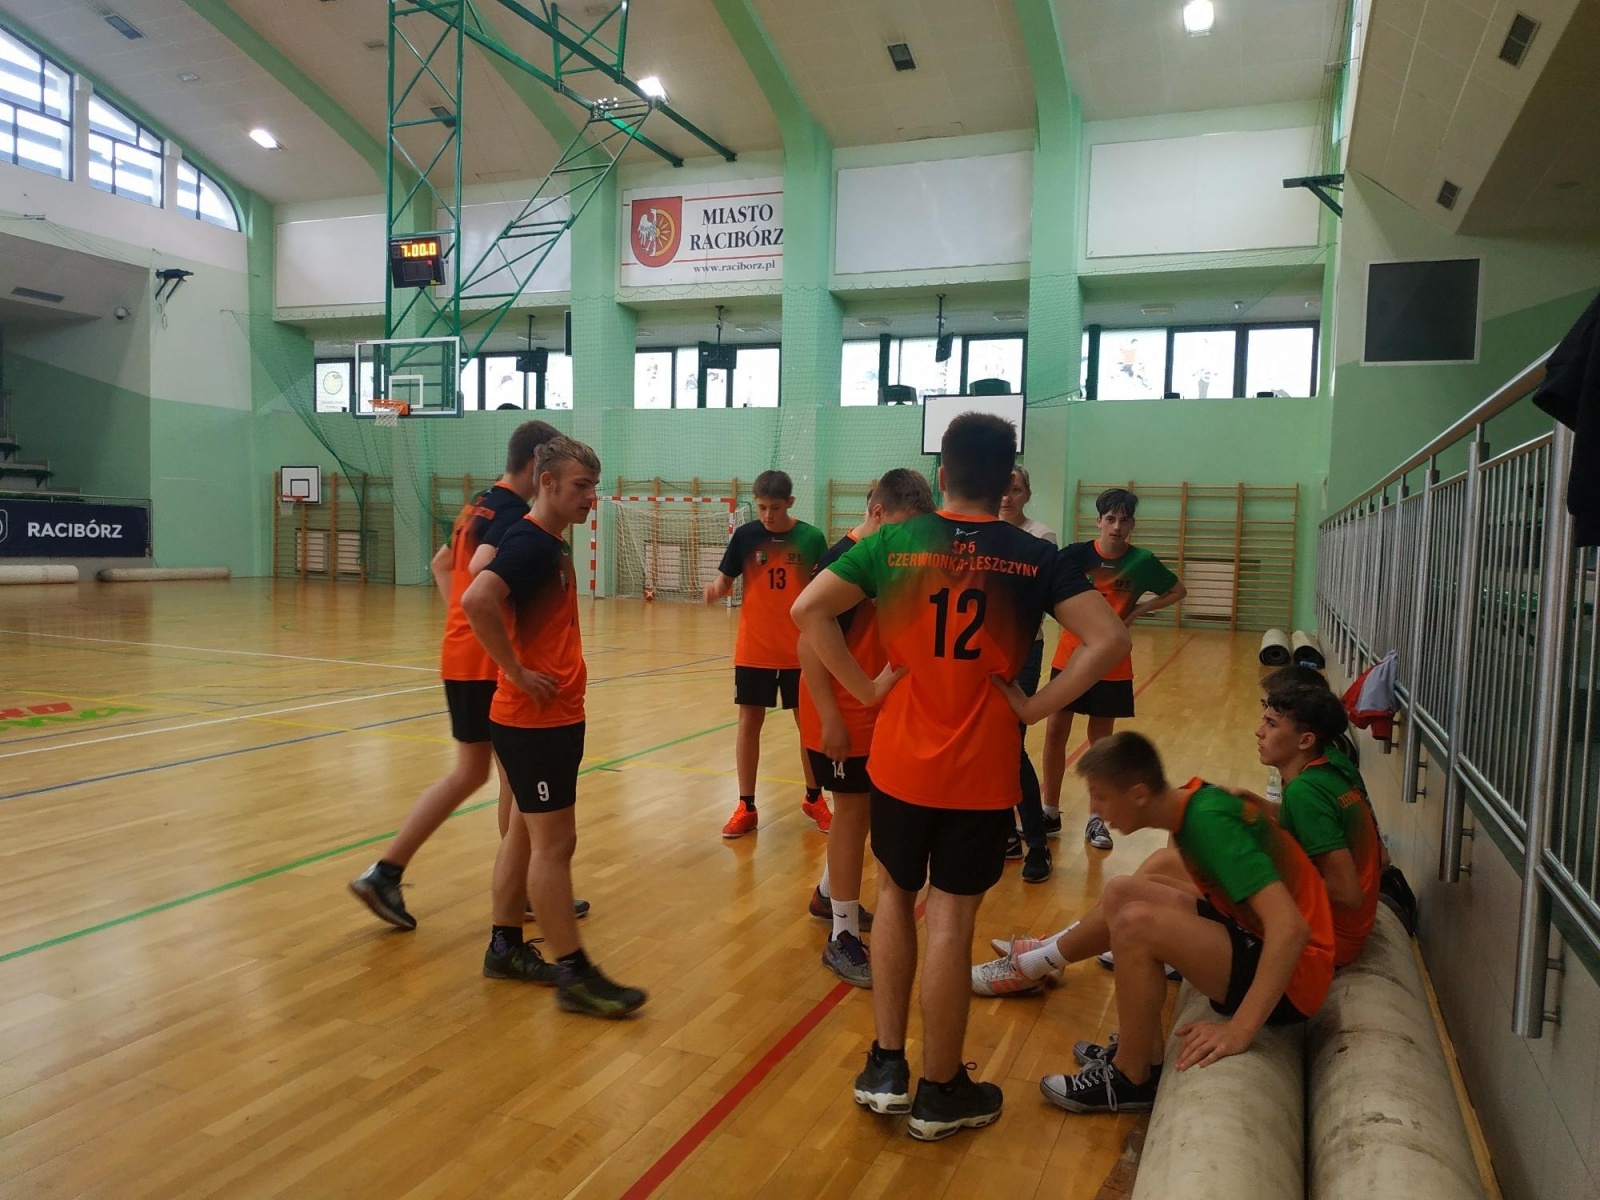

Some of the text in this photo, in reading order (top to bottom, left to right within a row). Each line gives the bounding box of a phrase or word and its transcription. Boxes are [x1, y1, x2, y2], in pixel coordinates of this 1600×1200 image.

[701, 203, 774, 226] MIASTO
[690, 225, 784, 251] RACIBÓRZ
[693, 260, 776, 273] www.raciborz.pl
[27, 519, 123, 539] RACIBÓRZ
[887, 552, 1039, 578] CZERWIONKA-LESZCZYNY
[767, 567, 787, 590] 13
[929, 587, 987, 661] 12
[831, 760, 846, 779] 14
[537, 781, 550, 802] 9
